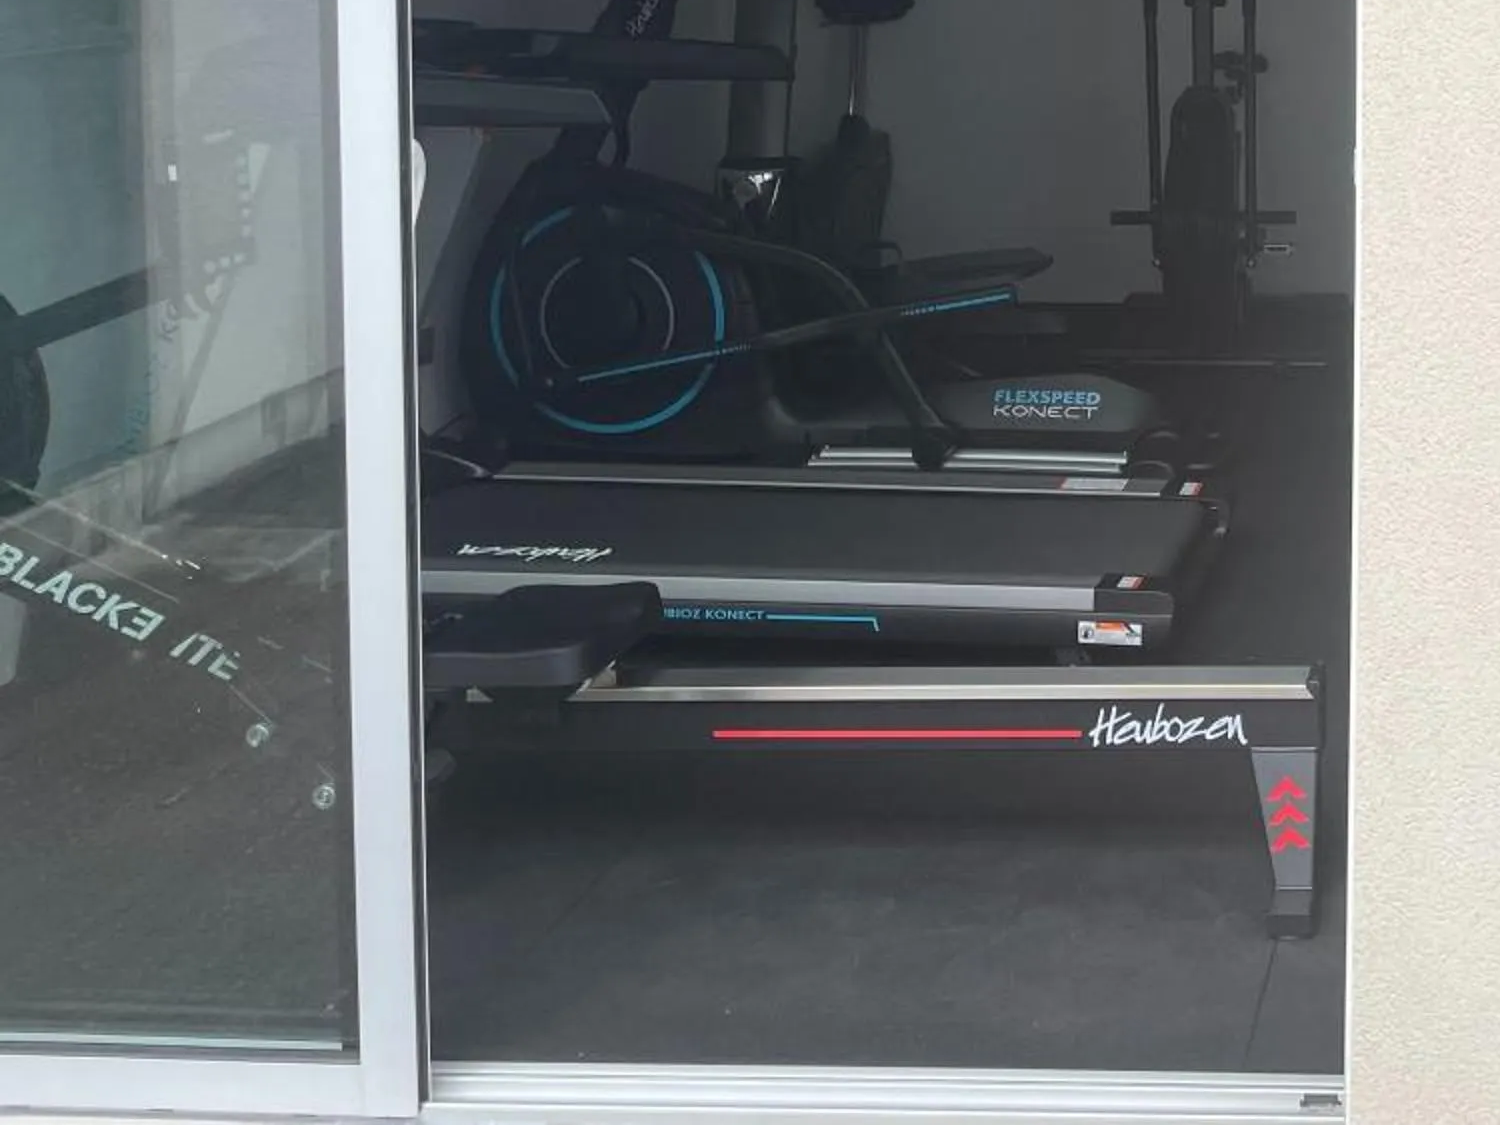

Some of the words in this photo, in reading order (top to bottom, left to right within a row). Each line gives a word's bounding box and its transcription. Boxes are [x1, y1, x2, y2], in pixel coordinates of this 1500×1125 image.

[994, 389, 1101, 405] FLEXSPEED
[992, 404, 1099, 419] KONECT
[705, 608, 765, 620] KONECT
